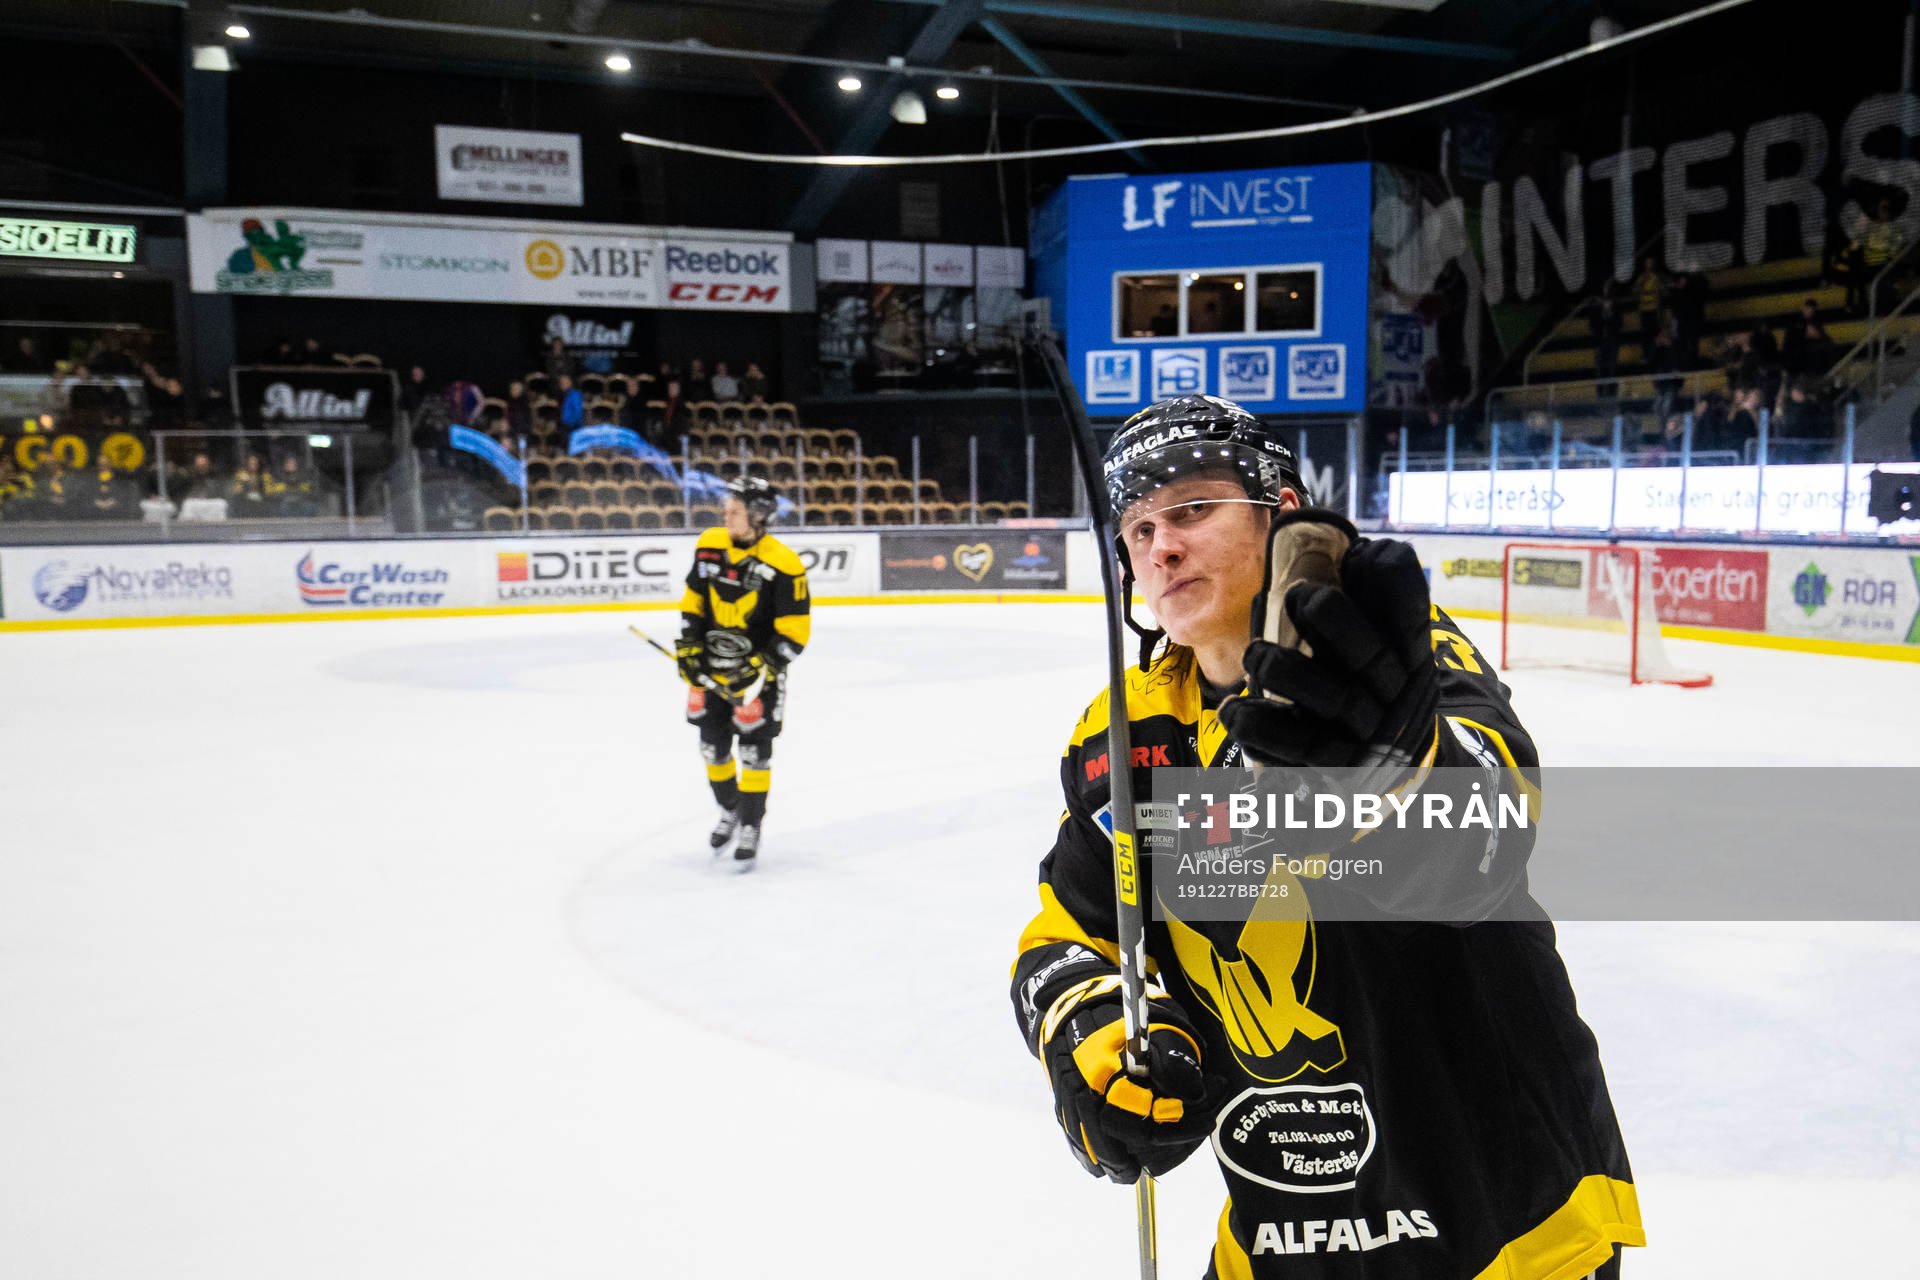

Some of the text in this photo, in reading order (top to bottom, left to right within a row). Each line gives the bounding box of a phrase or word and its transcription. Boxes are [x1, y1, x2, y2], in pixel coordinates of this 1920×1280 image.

[1123, 181, 1183, 231] LF
[570, 246, 653, 280] MBF
[665, 245, 779, 276] Reebok
[668, 282, 780, 305] CCM
[1263, 441, 1292, 458] CCM
[350, 584, 445, 606] Center
[1085, 745, 1171, 782] MRK
[1140, 808, 1173, 819] UNIBET
[1143, 835, 1176, 844] HOCKEY
[1117, 842, 1134, 895] CCM
[1317, 1099, 1364, 1121] Met
[1281, 1150, 1360, 1175] Västerås
